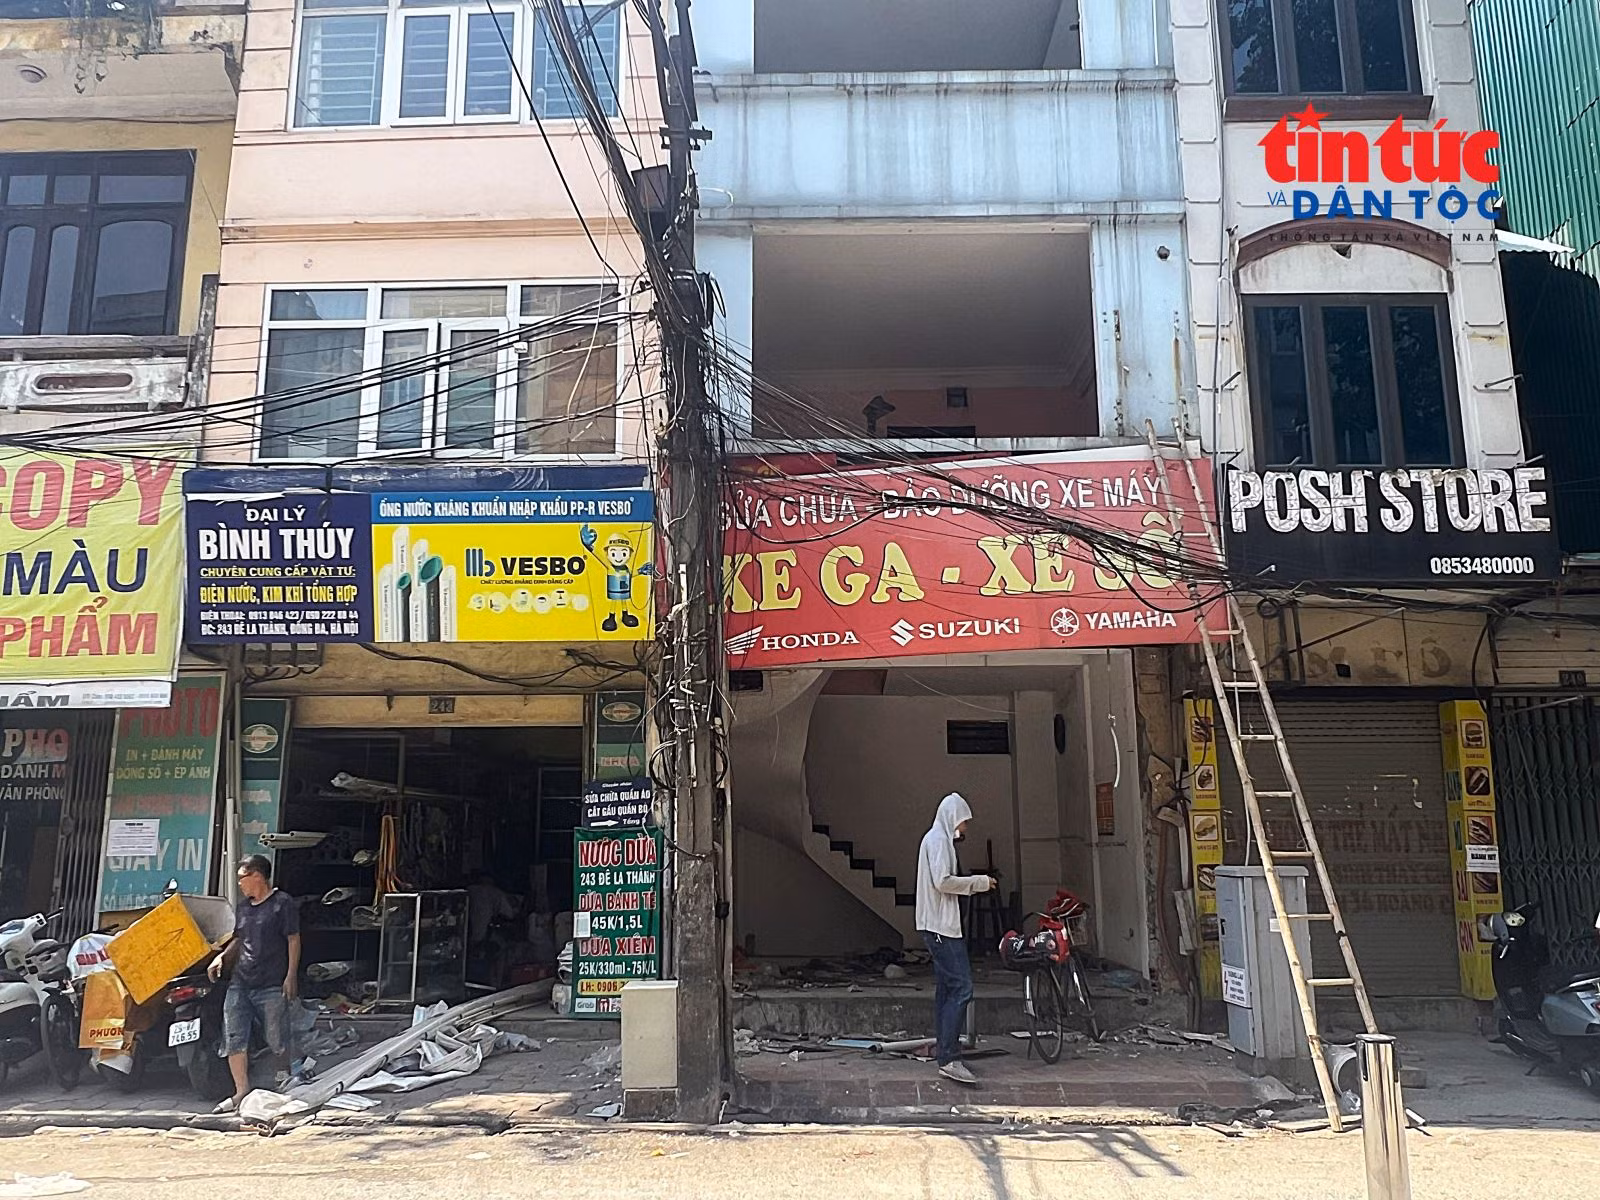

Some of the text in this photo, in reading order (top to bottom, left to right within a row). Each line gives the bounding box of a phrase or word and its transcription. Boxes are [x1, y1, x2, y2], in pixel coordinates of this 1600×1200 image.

[0, 457, 180, 531] OPY
[379, 498, 401, 517] ỐNG
[403, 498, 431, 517] NƯỚC
[471, 496, 507, 516] KHUẨN
[509, 499, 538, 519] NHẬP
[540, 495, 568, 516] KHẨU
[570, 501, 596, 516] PP-R
[882, 477, 942, 519] BẢO
[1058, 478, 1095, 509] XE
[1103, 470, 1161, 507] MÁY
[1228, 467, 1551, 533] POSH STORE
[246, 504, 306, 525] ĐẠI LÝ
[199, 522, 271, 560] BÌNH
[279, 521, 354, 560] THÚY
[3, 538, 149, 596] MÀU
[820, 542, 925, 606] GA
[977, 532, 1075, 596] XE
[1430, 557, 1534, 575] 0853480000
[200, 583, 225, 607] ĐIỆN
[262, 586, 284, 603] KIM
[285, 583, 304, 603] KHÍ
[306, 579, 334, 603] TỔNG
[0, 596, 158, 658] PHẨM
[217, 623, 233, 636] 243
[246, 623, 258, 636] LA
[761, 610, 1177, 651] HONDA SUZUKI YAMAHA
[176, 838, 204, 871] IN
[579, 833, 657, 867] NƯỚC DỪA
[580, 872, 596, 886] 243
[598, 869, 612, 886] ĐÊ
[613, 872, 624, 885] LA
[579, 889, 603, 913] DỪA
[605, 887, 639, 911] BÁNH
[591, 915, 643, 931] 45K/1,5L
[580, 932, 656, 956] DỪA XIÊM
[578, 961, 626, 976] 25K/330ml
[580, 981, 595, 992] LH:
[597, 981, 617, 992] 0906
